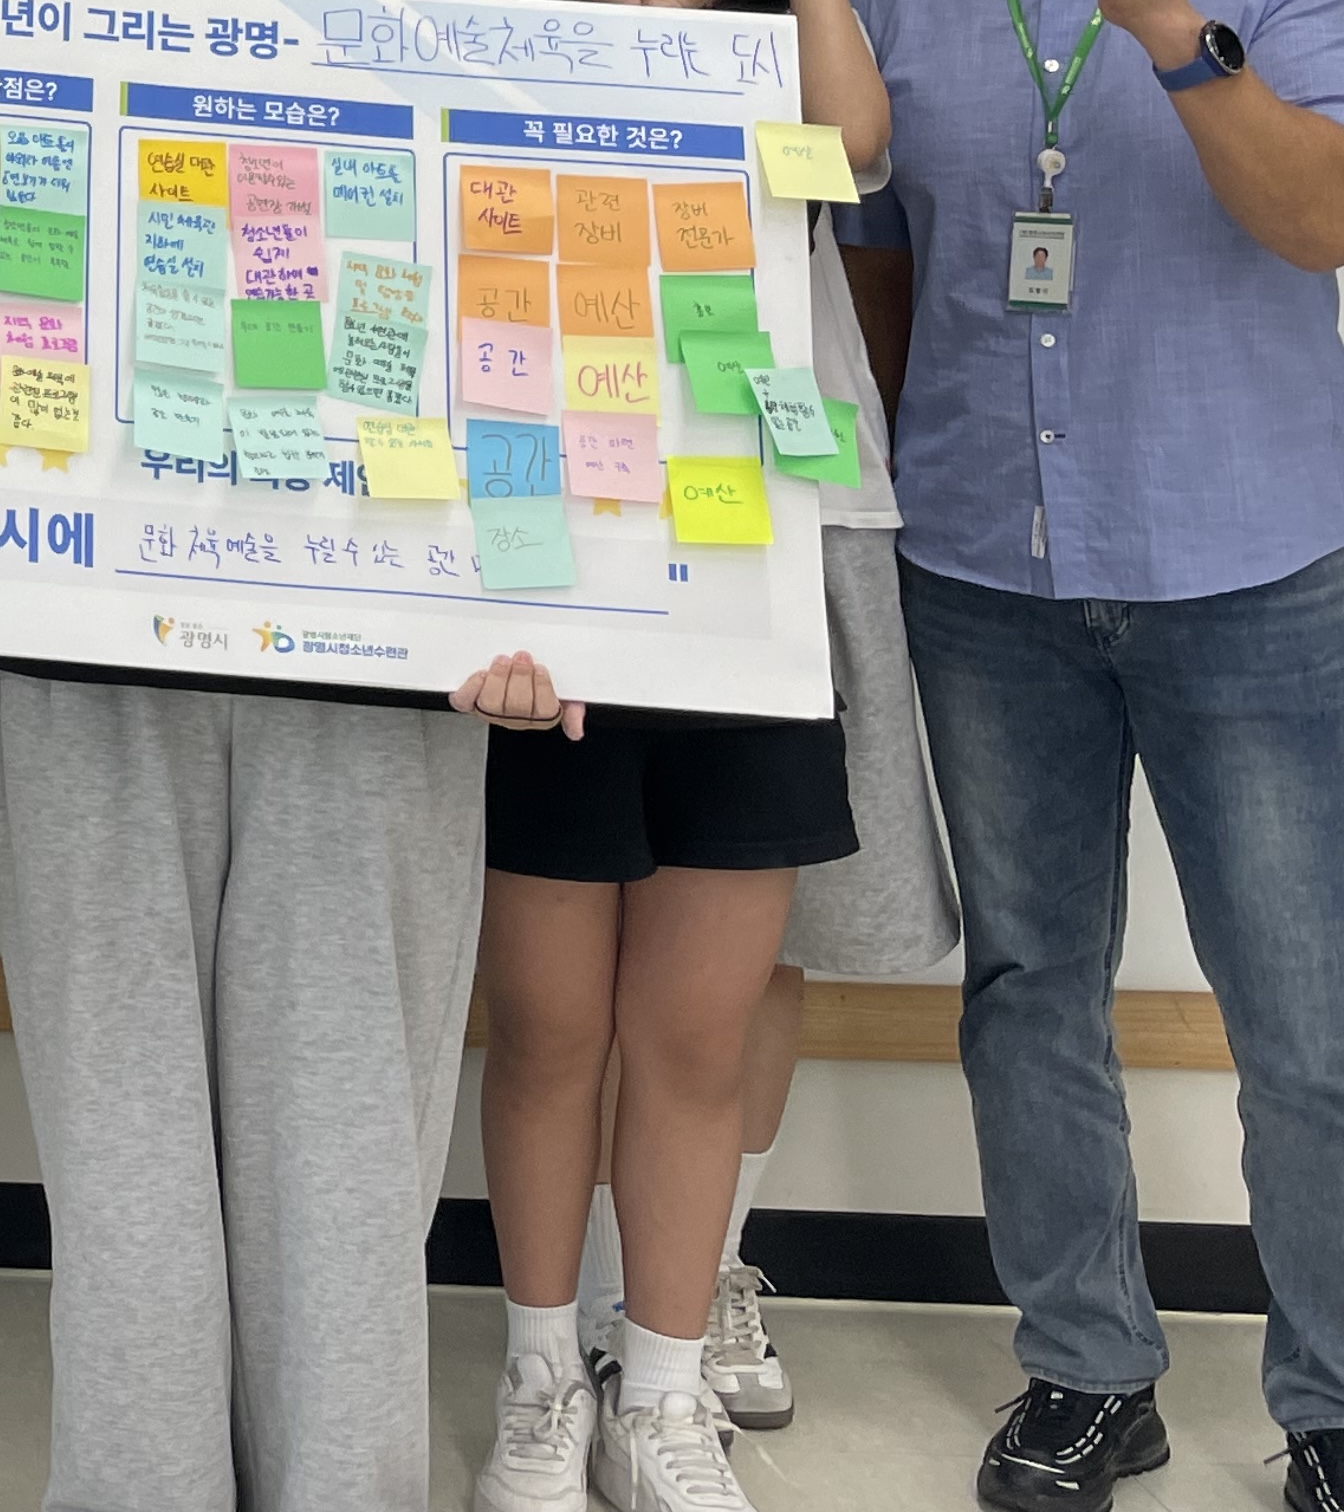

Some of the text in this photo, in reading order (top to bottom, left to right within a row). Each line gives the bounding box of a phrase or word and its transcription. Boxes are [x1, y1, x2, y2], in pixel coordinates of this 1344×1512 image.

[83, 5, 195, 53] 그리는
[204, 17, 300, 60] 광명-
[191, 94, 341, 128] 원하는 모습은?
[523, 120, 683, 152] 꼭 필요한 것은?
[469, 179, 517, 203] 대관
[575, 188, 621, 212] 관련
[573, 220, 623, 245] 장비
[476, 286, 533, 324] 공간
[573, 287, 641, 331] 예산
[477, 342, 529, 377] 공간
[577, 361, 651, 404] 예산
[486, 526, 545, 553] 장소
